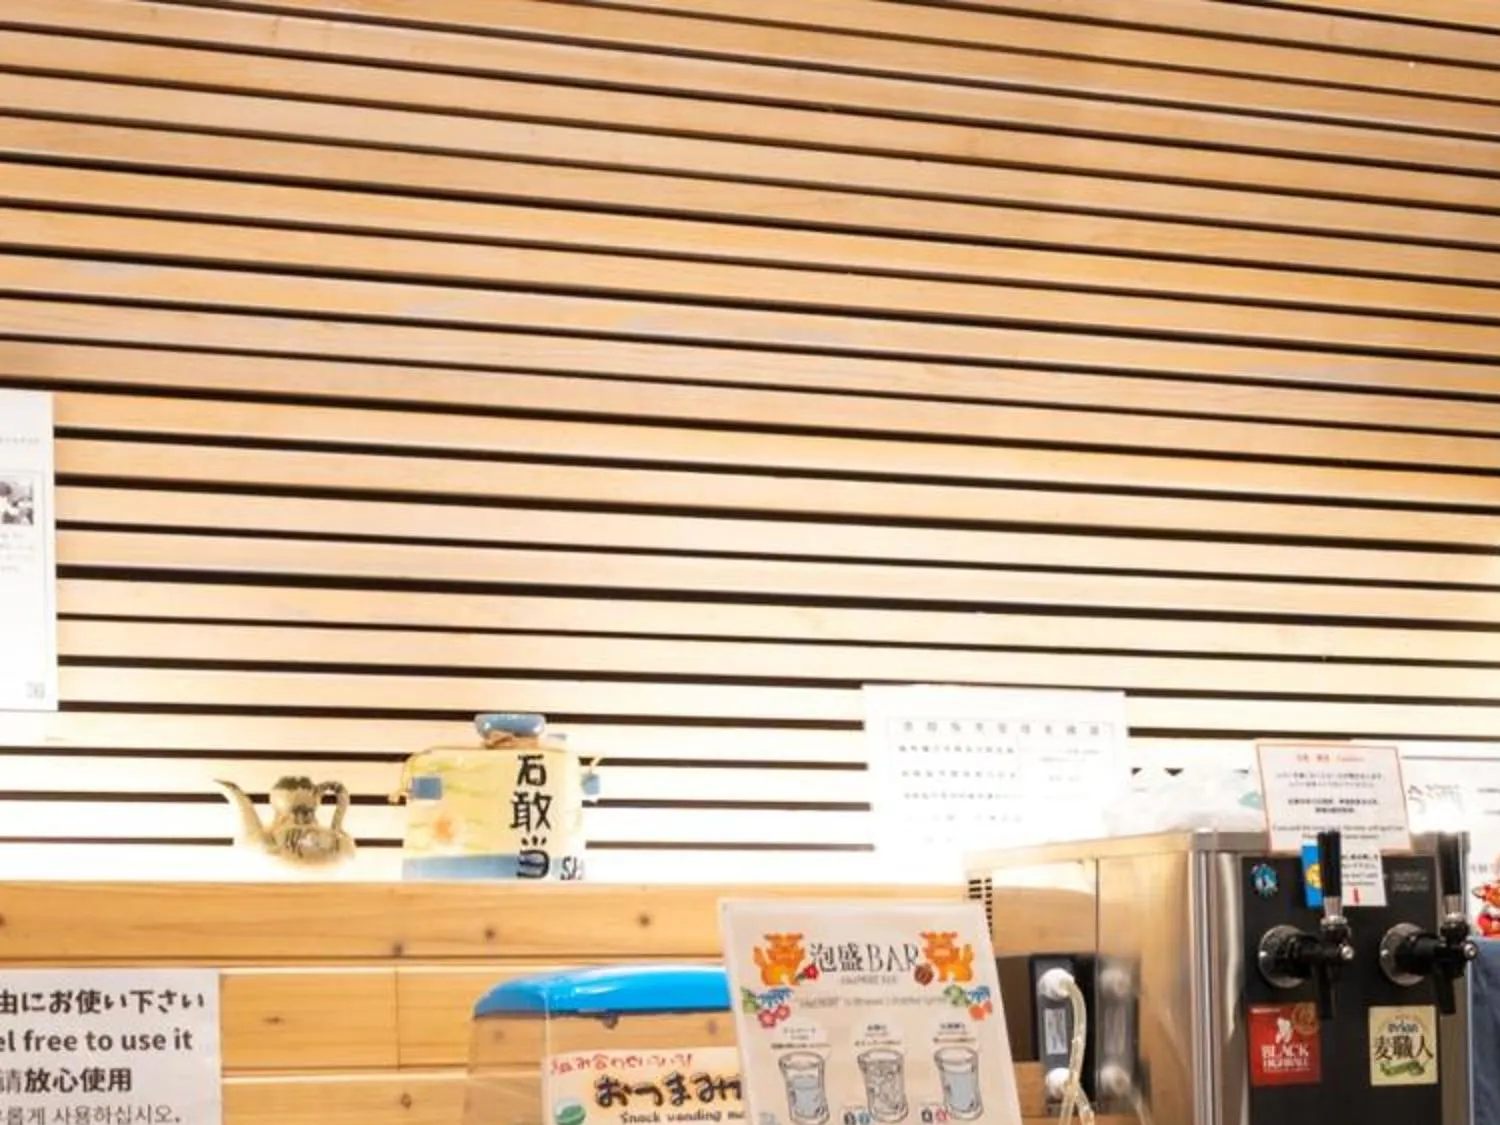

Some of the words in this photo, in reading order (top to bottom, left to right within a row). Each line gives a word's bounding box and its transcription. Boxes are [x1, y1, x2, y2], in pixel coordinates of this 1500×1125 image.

[509, 753, 552, 880] 石敢当
[808, 941, 920, 973] 泡盛BAR
[0, 988, 206, 1015] 由にお使い下さい
[23, 1029, 78, 1051] free
[85, 1031, 113, 1051] to
[121, 1033, 167, 1051] use
[174, 1027, 193, 1050] it
[1261, 1044, 1309, 1057] BLACK
[1374, 1034, 1434, 1060] 麦職人
[620, 1110, 661, 1124] Snack
[667, 1110, 722, 1123] vending
